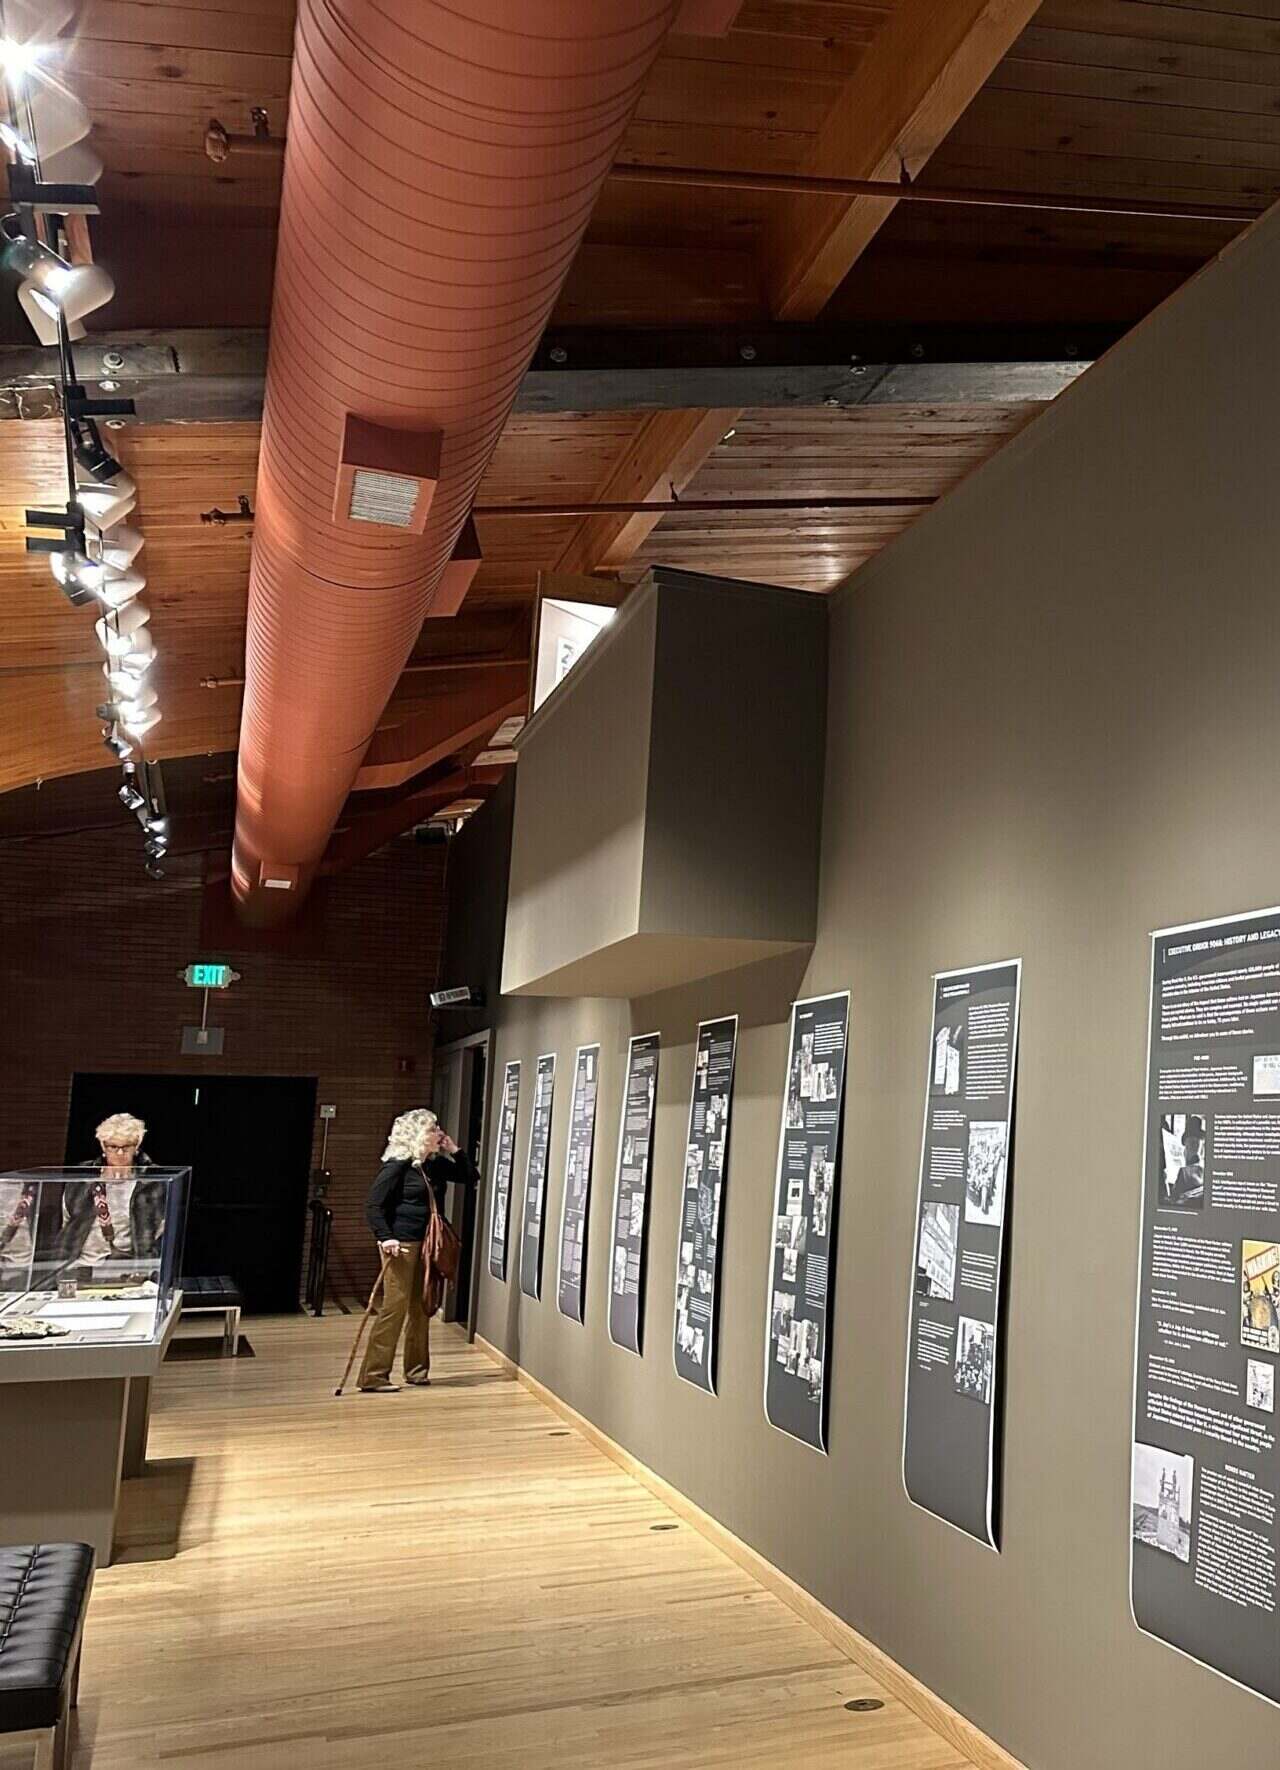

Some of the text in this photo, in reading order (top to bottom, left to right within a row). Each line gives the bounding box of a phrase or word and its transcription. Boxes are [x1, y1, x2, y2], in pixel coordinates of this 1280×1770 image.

[1223, 935, 1247, 946] HISTORY
[1247, 932, 1259, 942] AND
[193, 965, 225, 985] EXIT
